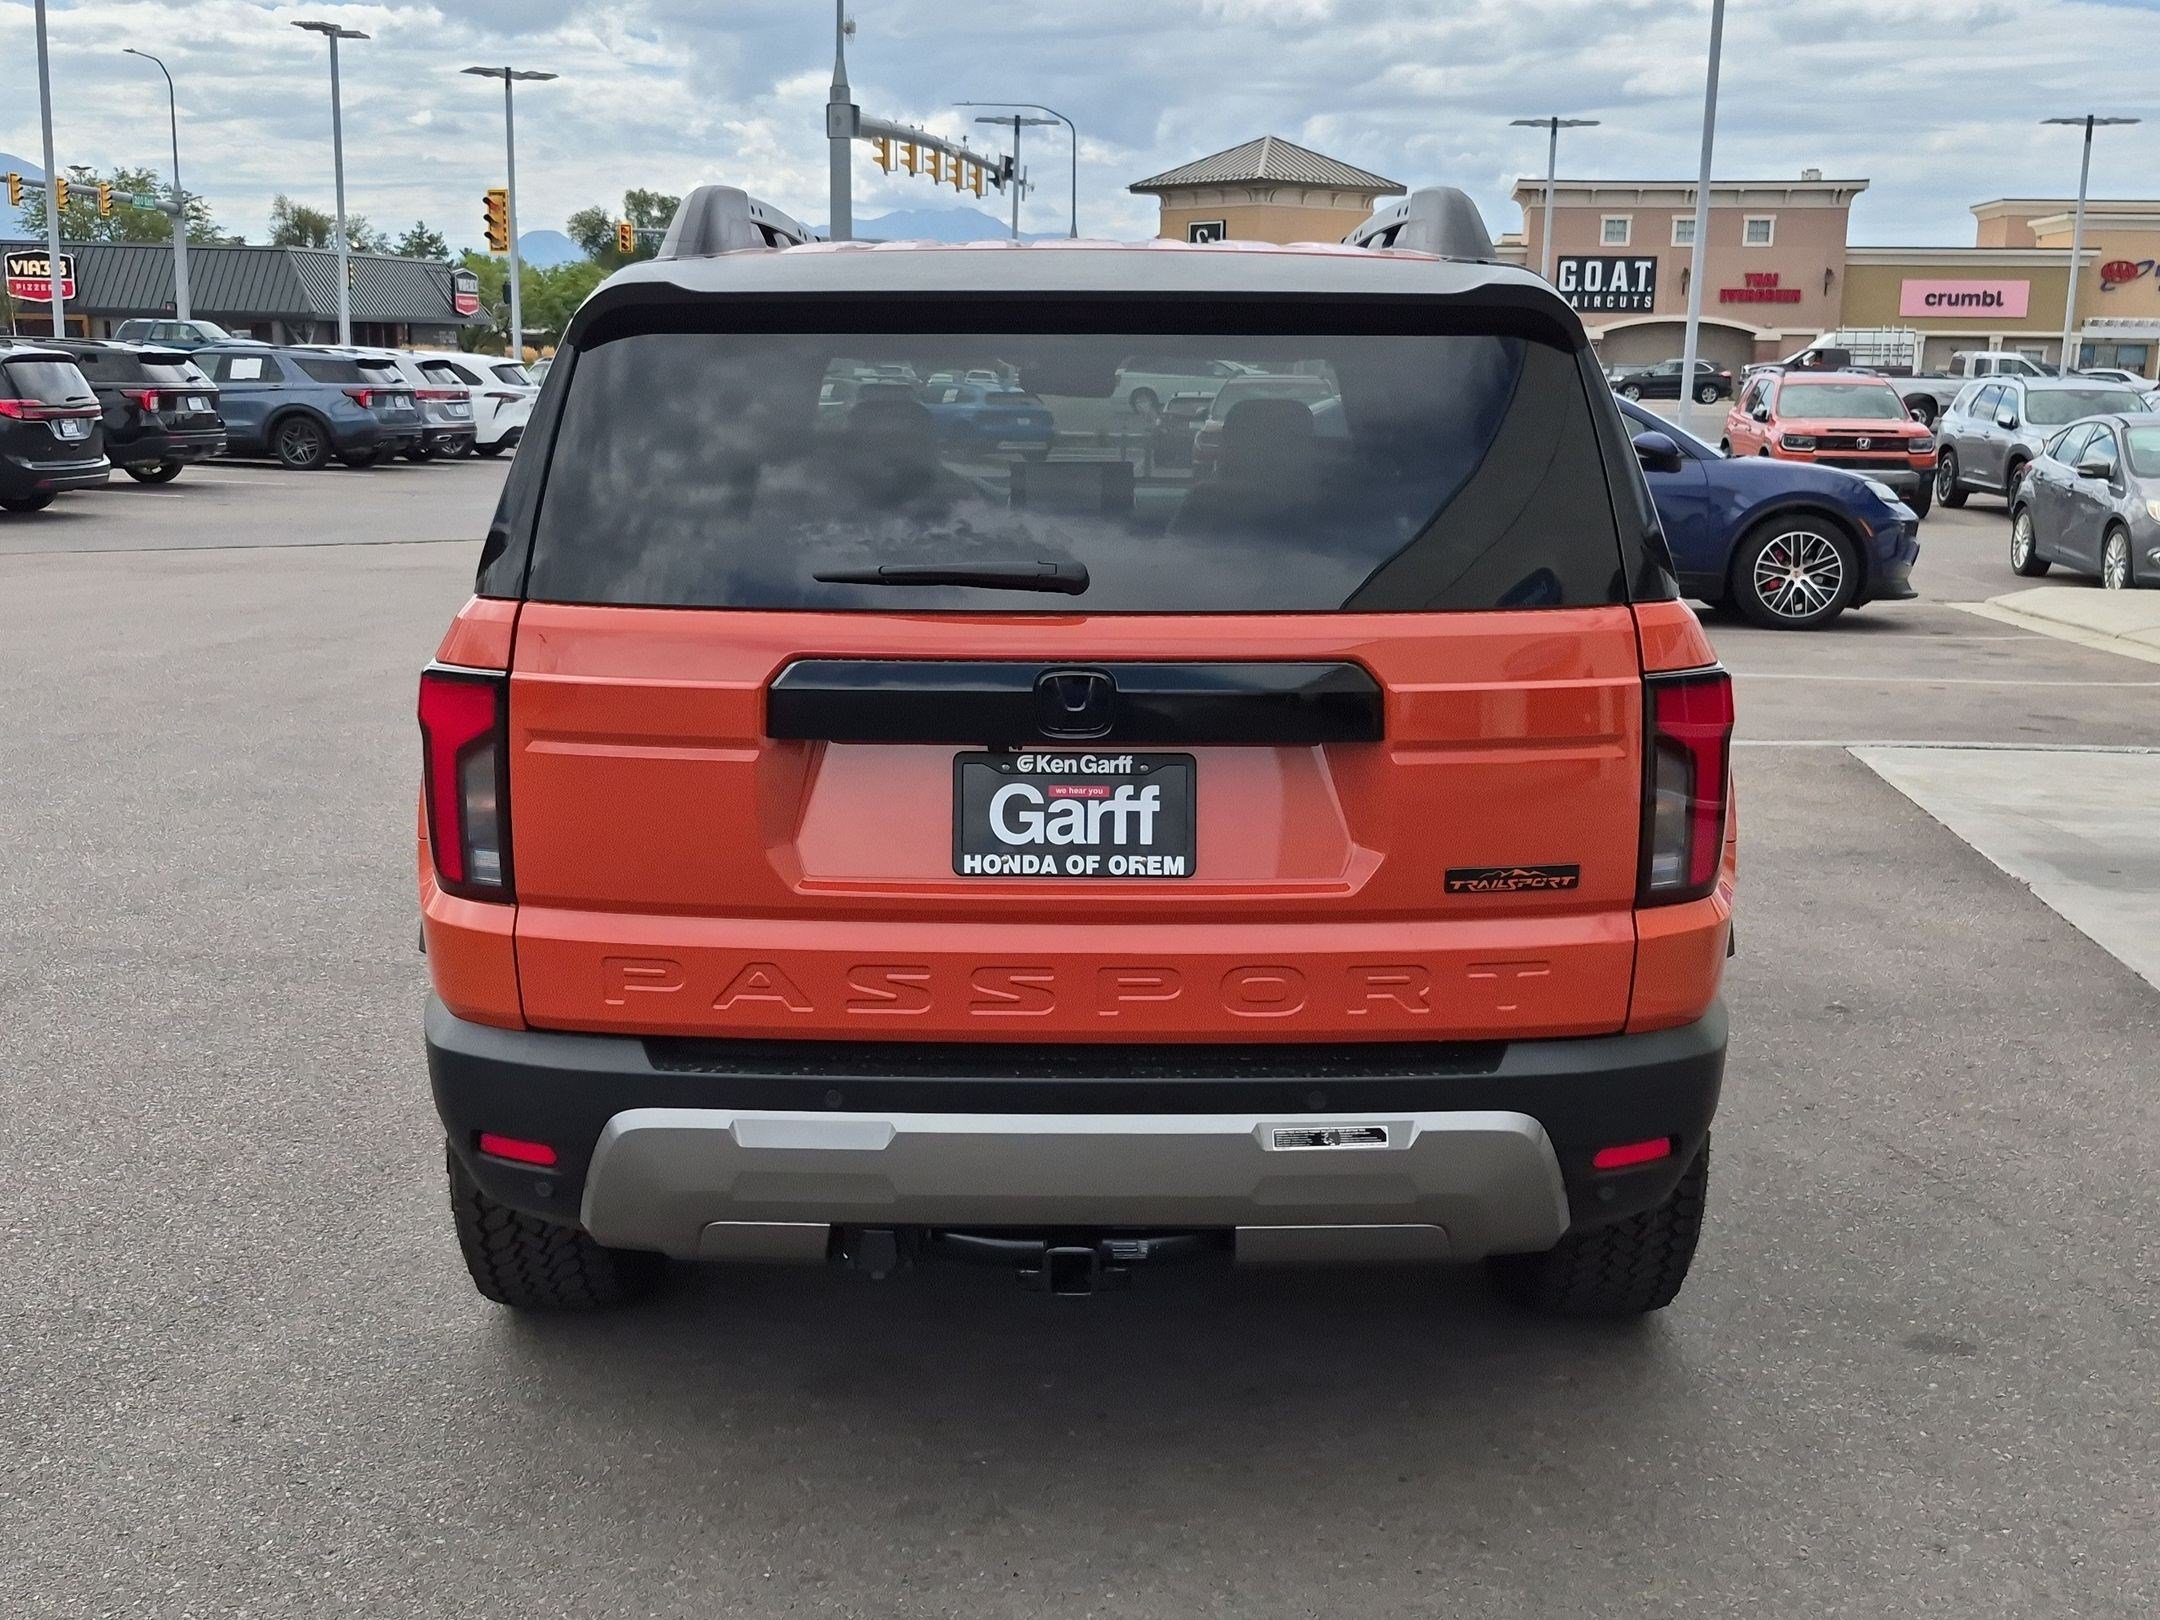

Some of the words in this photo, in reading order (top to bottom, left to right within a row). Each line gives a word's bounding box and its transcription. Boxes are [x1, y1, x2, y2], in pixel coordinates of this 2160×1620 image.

[10, 260, 67, 275] VIA33
[1559, 261, 1652, 292] G.O.A.T.
[16, 283, 66, 292] PIZZERA
[1570, 295, 1652, 308] AIRCUTS
[1924, 290, 2004, 307] crumbl
[1036, 754, 1077, 774] Ken
[1081, 754, 1133, 774] Garff
[1055, 787, 1067, 795] we
[1069, 786, 1086, 795] hear
[1088, 787, 1104, 796] you
[989, 782, 1161, 846] Garff
[963, 854, 1058, 875] HONDA
[1065, 854, 1100, 875] OF
[1108, 855, 1185, 876] OREM
[1450, 876, 1577, 892] TRAILSPORT
[601, 956, 1551, 1017] PASSPORT
